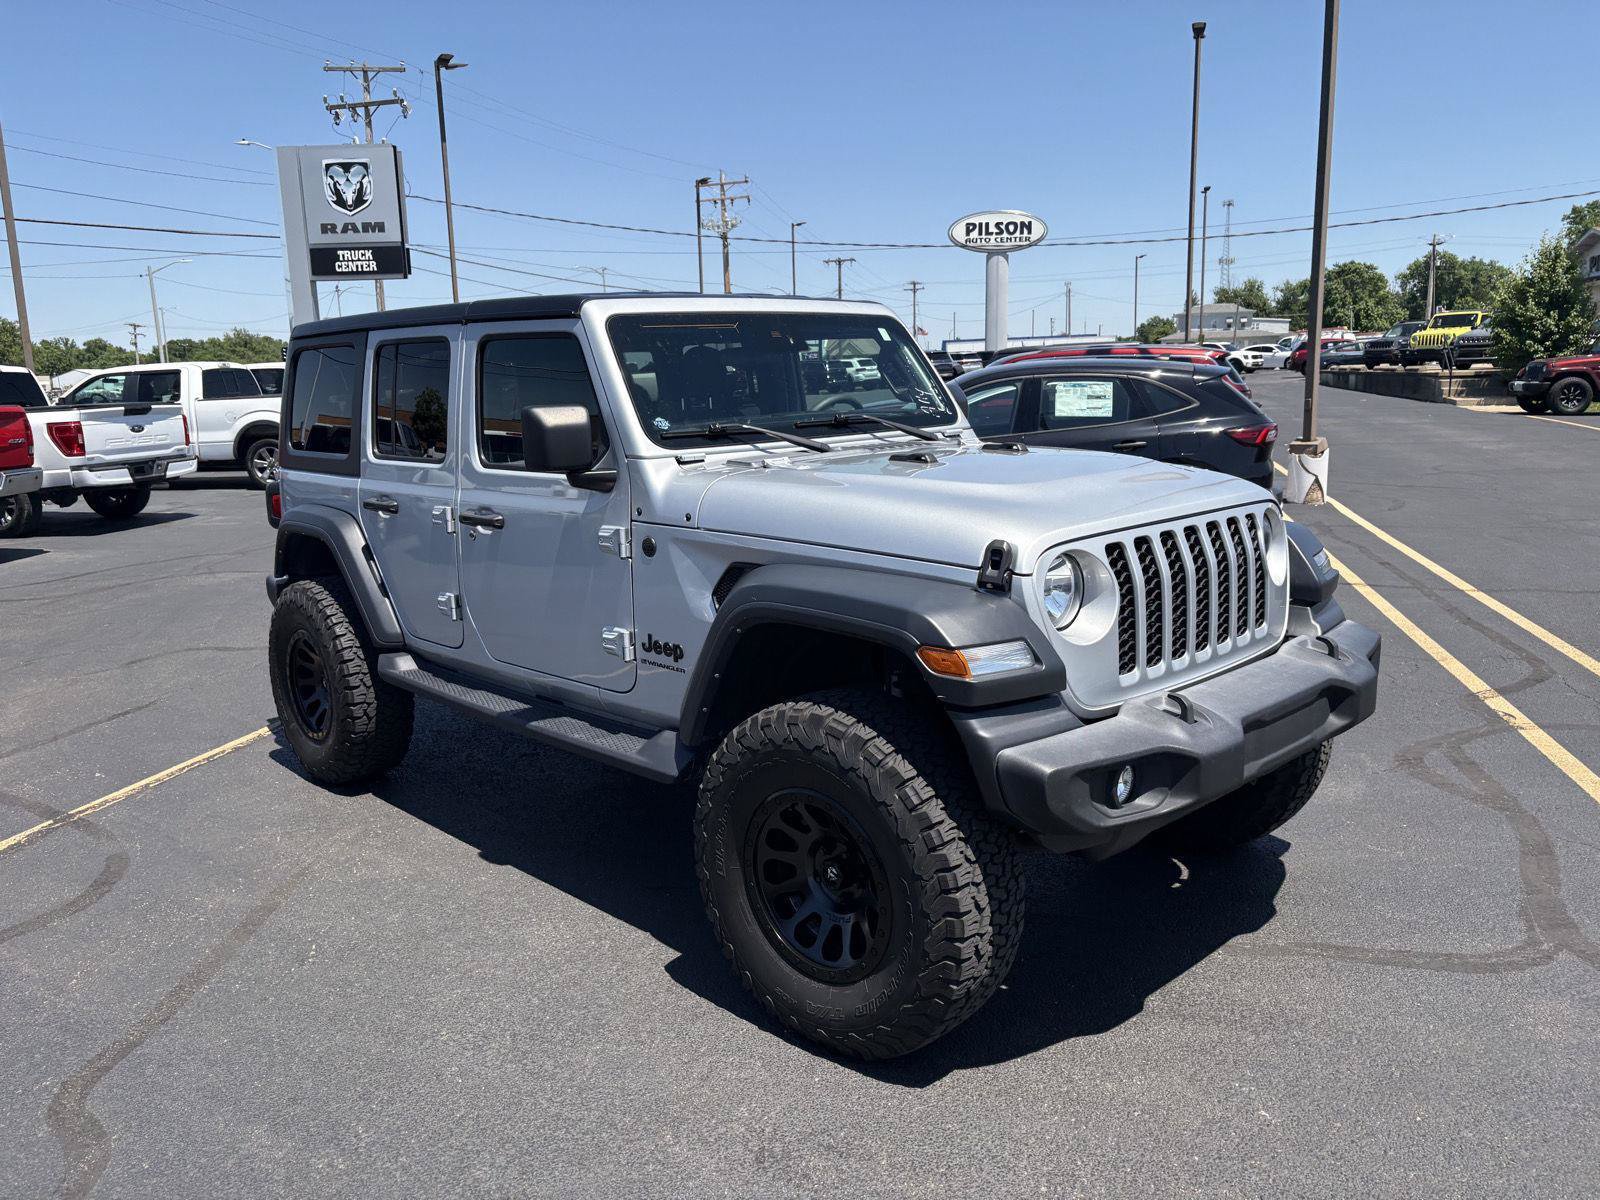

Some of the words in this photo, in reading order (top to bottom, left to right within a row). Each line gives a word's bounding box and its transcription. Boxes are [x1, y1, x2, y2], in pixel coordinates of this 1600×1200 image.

[320, 222, 386, 235] RAM
[965, 221, 1033, 237] PILSON
[965, 237, 991, 245] AUTO
[994, 236, 1032, 244] CENTER
[337, 250, 374, 261] TRUCK
[335, 261, 378, 272] CENTER
[641, 633, 684, 662] Jeep
[647, 659, 686, 674] WRANGLER
